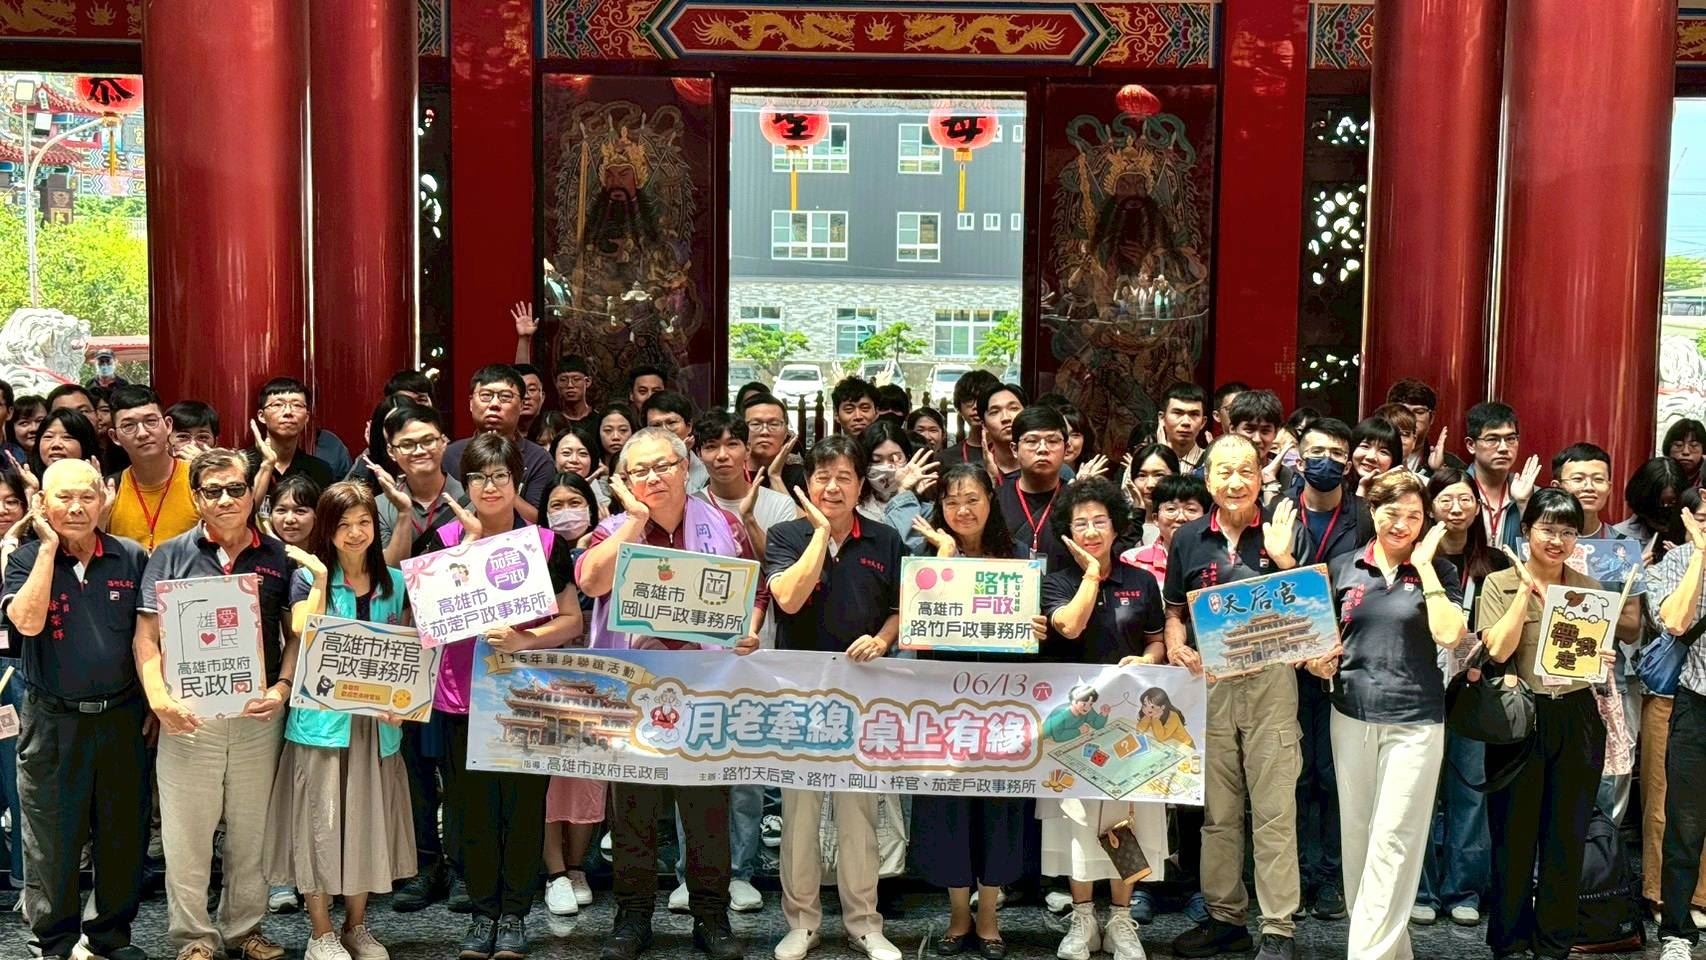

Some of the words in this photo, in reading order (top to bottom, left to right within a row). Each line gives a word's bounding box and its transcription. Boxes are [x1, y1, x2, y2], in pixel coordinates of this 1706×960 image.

[437, 588, 488, 617] 高雄市
[633, 581, 686, 603] 高雄市
[972, 596, 1014, 615] 戶政
[429, 591, 547, 638] 茄萣戶政事務所
[621, 600, 743, 631] 岡山戶政事務所
[918, 601, 963, 617] 高雄市
[910, 619, 1032, 640] 路竹戶政事務所
[322, 631, 422, 663] 高雄市梓官
[1550, 621, 1597, 671] 帶我走
[177, 656, 251, 676] 高雄市政府
[317, 653, 421, 685] 戶政事務所
[499, 653, 635, 680] 115年單身聯誼活動
[180, 672, 253, 699] 民政局
[953, 671, 1028, 697] 06/13
[1034, 682, 1051, 699] 六
[687, 701, 853, 748] 月老牽線
[860, 710, 1032, 759] 桌上有緣
